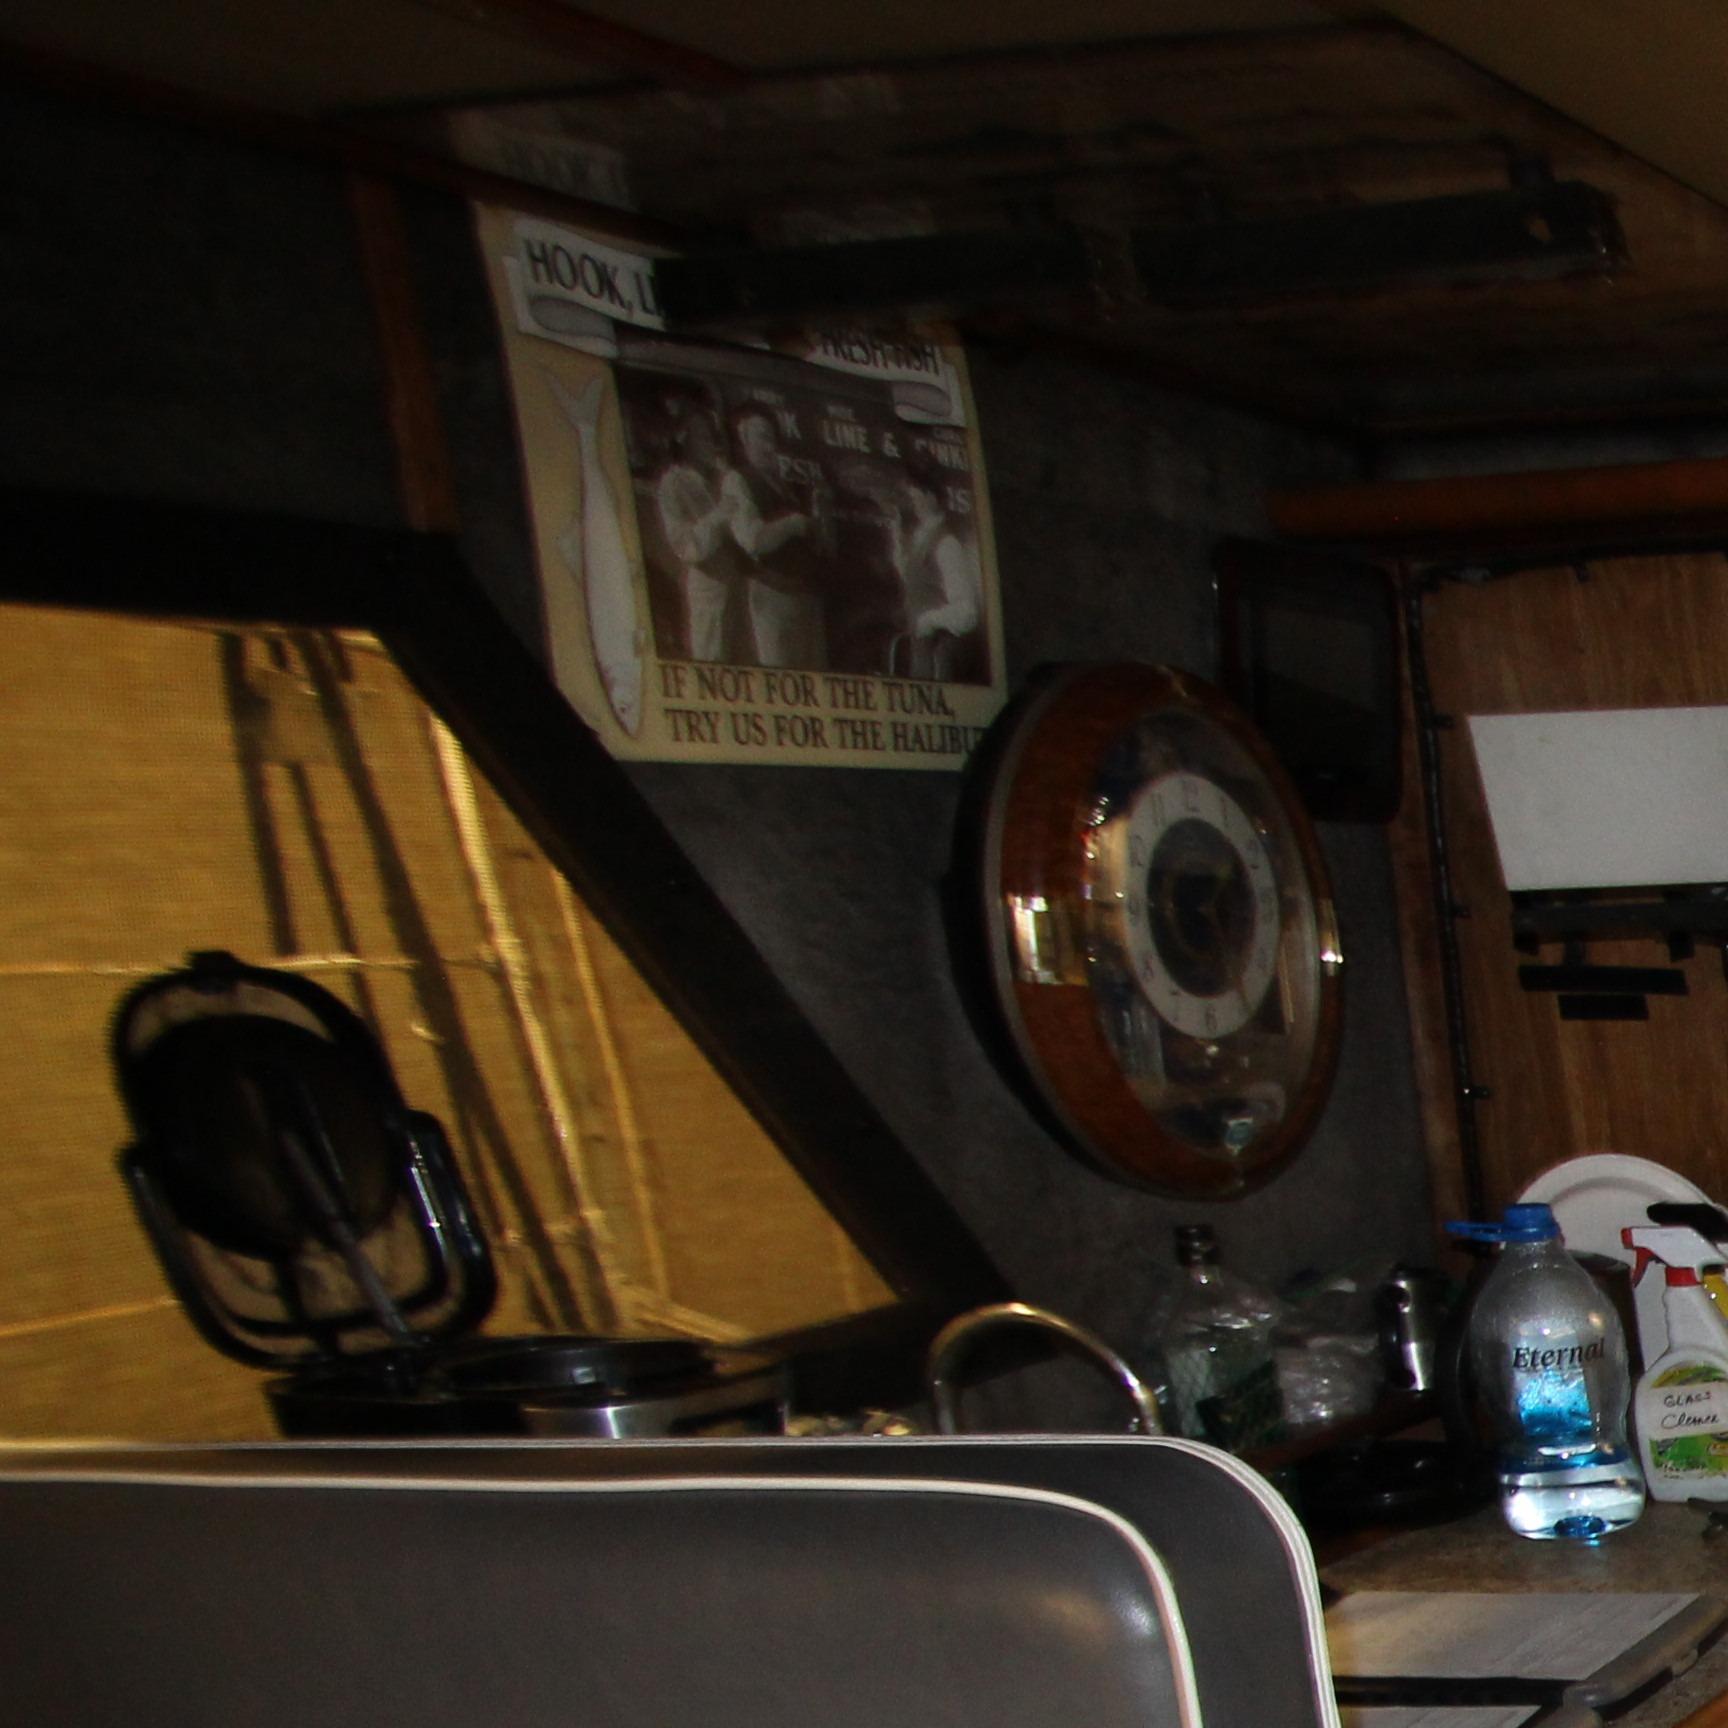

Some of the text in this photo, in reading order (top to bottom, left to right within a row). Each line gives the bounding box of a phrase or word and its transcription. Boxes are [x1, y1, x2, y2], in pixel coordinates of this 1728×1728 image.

[525, 238, 633, 320] HOOK,
[822, 417, 871, 454] LINE
[659, 663, 955, 720] IF NOT FOR THE TUNA,
[664, 708, 720, 744] TRY
[730, 711, 768, 747] US
[772, 714, 828, 749] FOR
[833, 718, 885, 751] THE
[1513, 1338, 1605, 1369] Eternal
